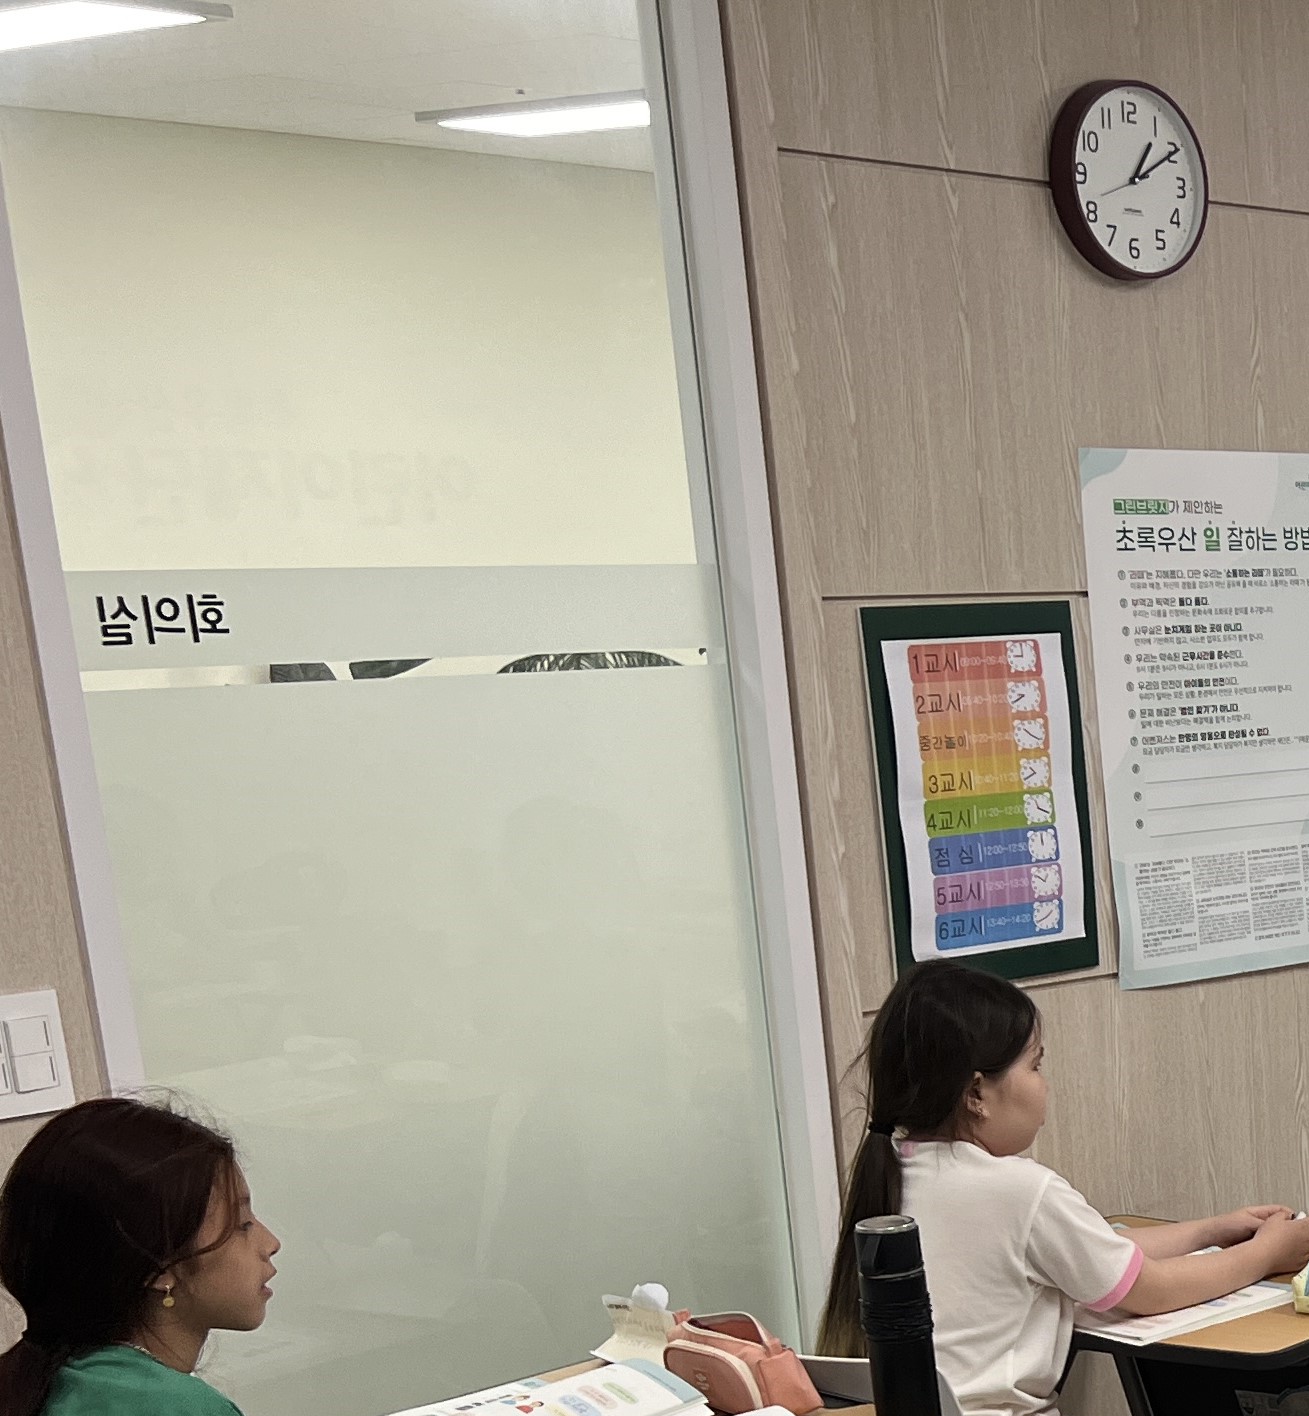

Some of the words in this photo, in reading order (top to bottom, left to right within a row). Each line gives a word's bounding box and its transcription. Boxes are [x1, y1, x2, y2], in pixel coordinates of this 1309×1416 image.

[1101, 107, 1111, 129] 11
[1121, 100, 1137, 124] 12
[1082, 130, 1099, 152] 10
[1075, 162, 1087, 184] 9
[1176, 177, 1186, 199] 3
[1086, 201, 1098, 222] 8
[1170, 208, 1181, 228] 4
[1106, 224, 1117, 247] 7
[1155, 229, 1166, 250] 5
[1128, 238, 1140, 259] 6
[1113, 500, 1179, 515] 그린브릿지가
[1183, 500, 1223, 515] 제안하는
[1116, 525, 1197, 552] 초록우산
[1203, 526, 1221, 552] 일
[1226, 525, 1277, 552] 잘하는
[912, 652, 959, 674] 1교시
[916, 692, 961, 714] 2교시
[929, 771, 973, 793] 3교시
[926, 809, 971, 831] 4교시
[935, 848, 949, 868] 점
[958, 845, 973, 865] 심
[936, 882, 981, 905] 5교시
[939, 916, 983, 940] 6교시
